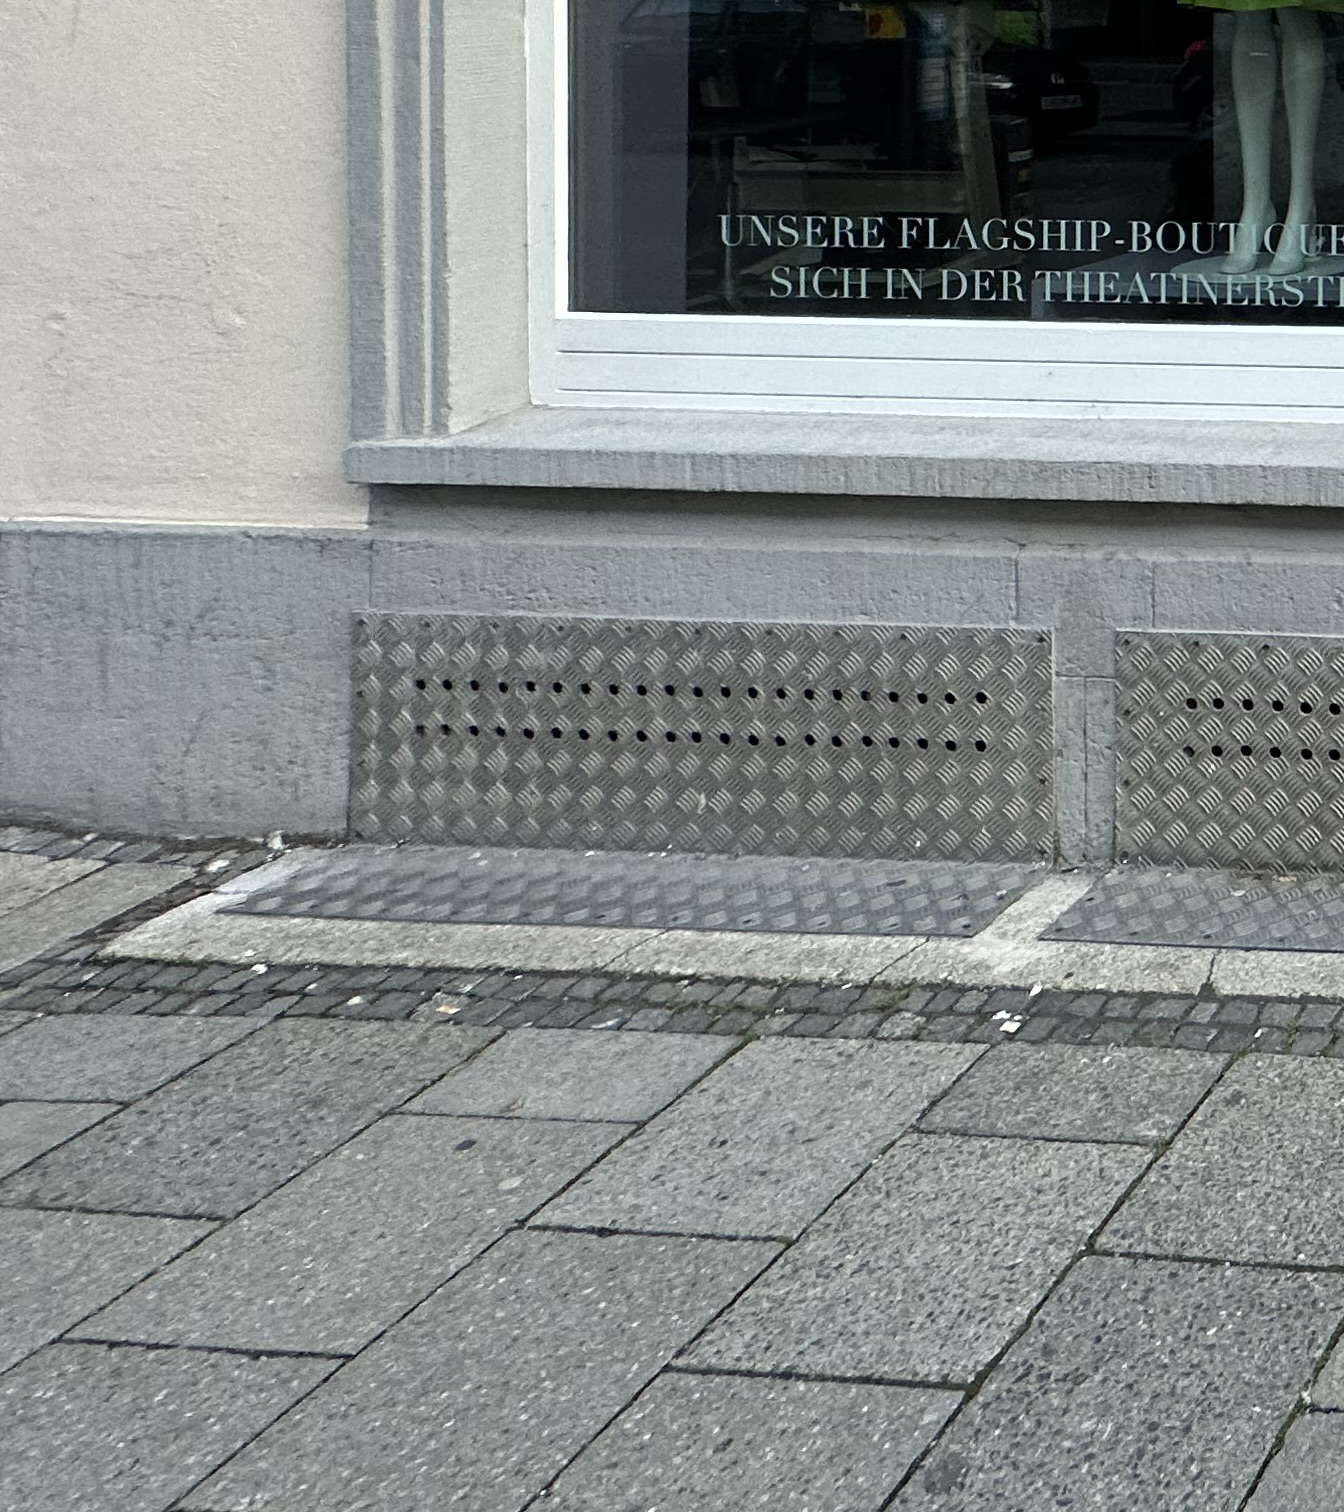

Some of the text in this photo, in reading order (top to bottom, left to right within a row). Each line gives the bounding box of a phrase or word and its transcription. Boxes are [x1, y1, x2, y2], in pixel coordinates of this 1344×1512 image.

[717, 214, 885, 249] UNSERE
[769, 265, 870, 299] SICH
[882, 268, 924, 300] IN
[938, 268, 1026, 302] DER
